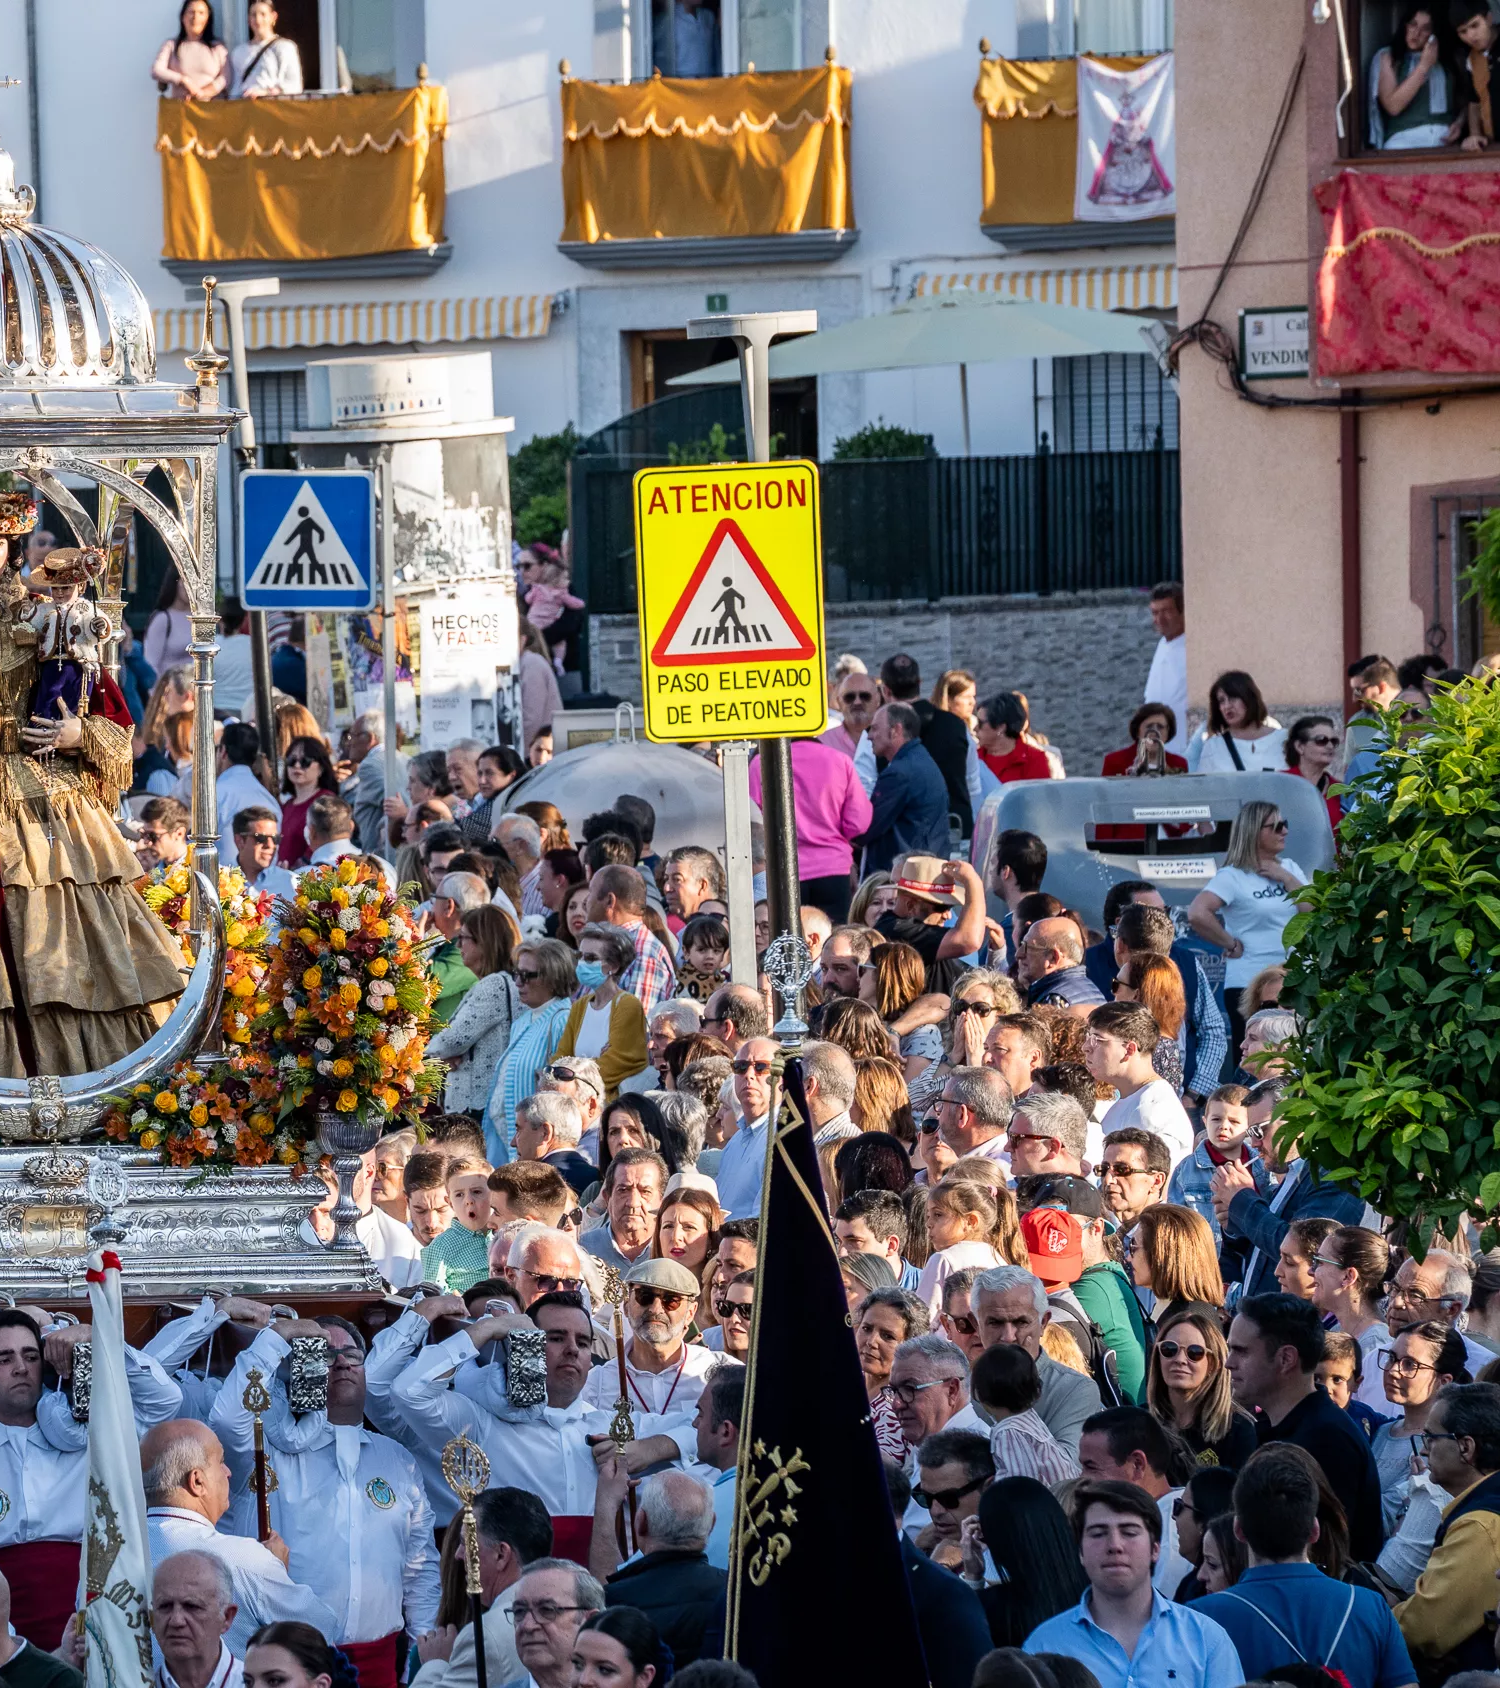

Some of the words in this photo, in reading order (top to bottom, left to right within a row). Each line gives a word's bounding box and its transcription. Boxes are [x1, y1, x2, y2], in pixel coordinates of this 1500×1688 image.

[648, 479, 807, 515] ATENCION
[432, 613, 499, 630] HECHOS
[433, 631, 444, 646] Y
[447, 630, 499, 646] FALTAS
[657, 672, 709, 694] PASO
[719, 667, 811, 691] ELEVADO
[667, 706, 692, 725] DE
[702, 698, 806, 723] PEATONES
